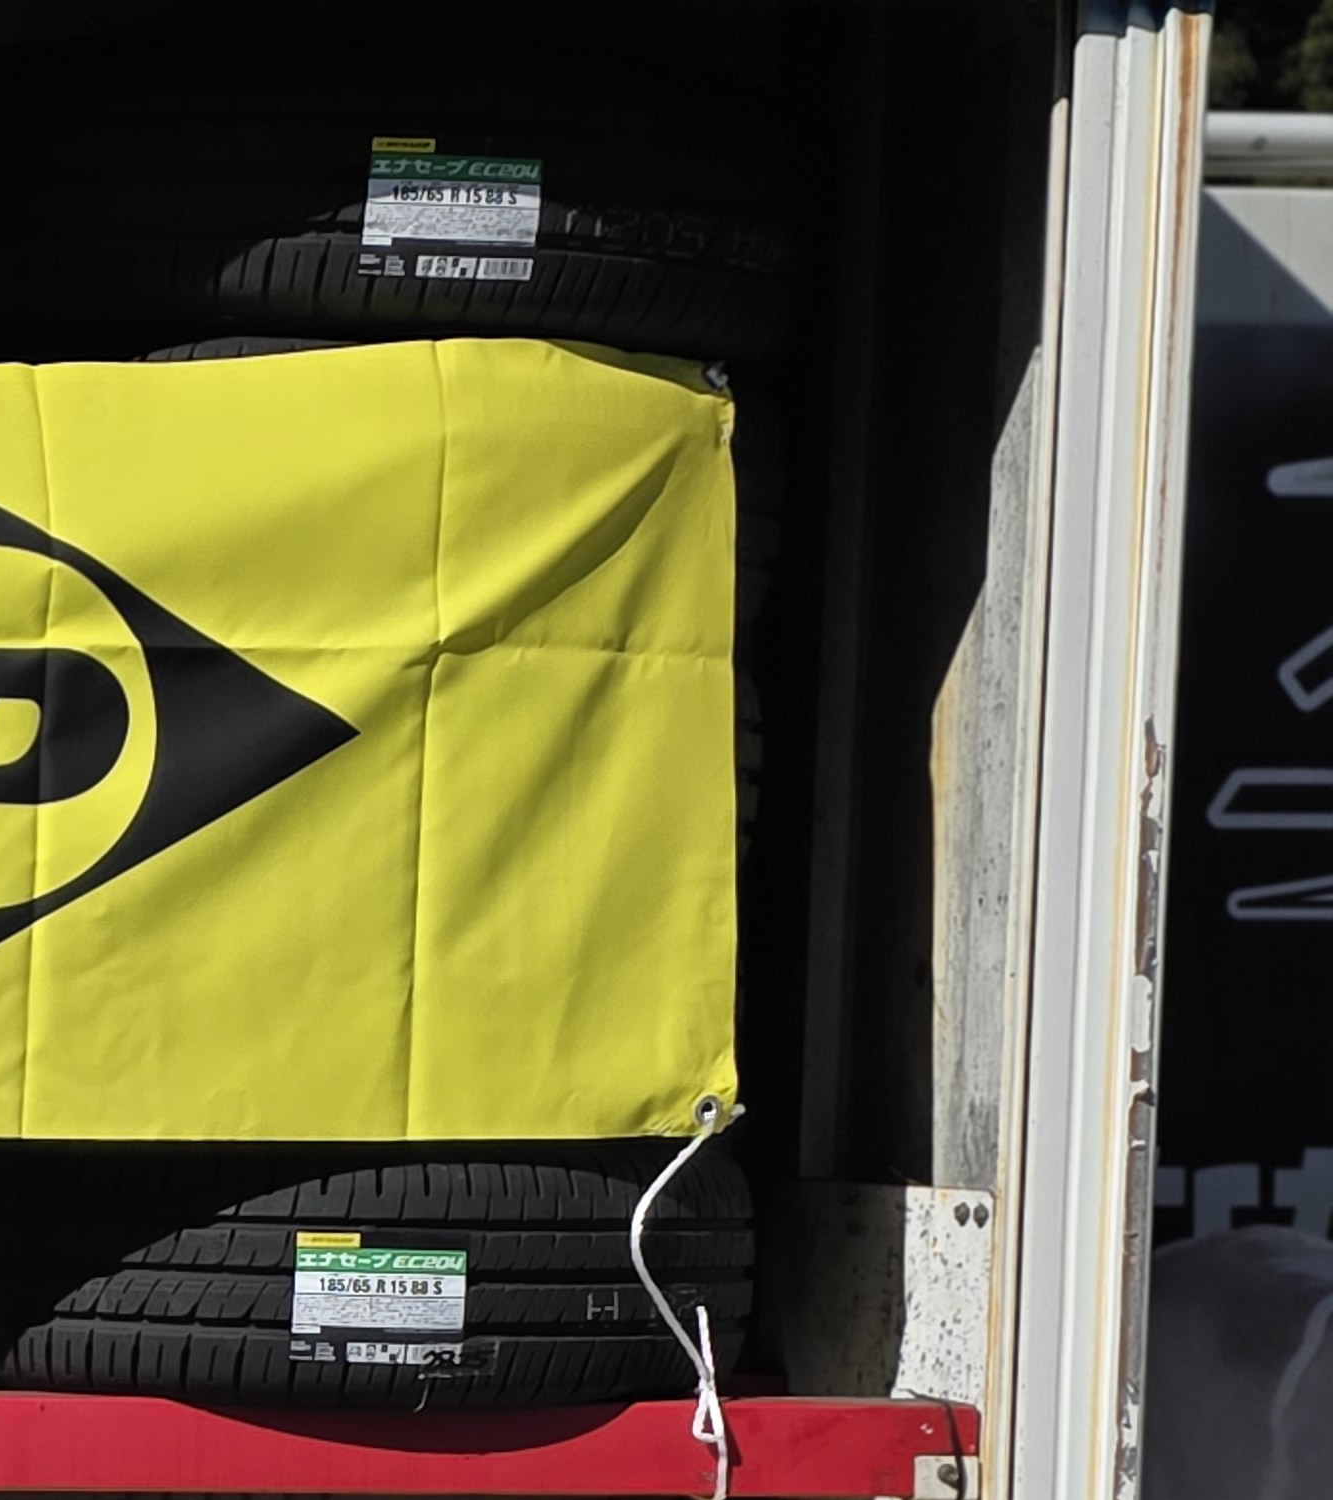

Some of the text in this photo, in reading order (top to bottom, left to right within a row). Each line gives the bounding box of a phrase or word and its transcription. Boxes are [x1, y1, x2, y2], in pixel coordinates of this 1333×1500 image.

[298, 1252, 464, 1270] エナセーブ EC204
[319, 1278, 443, 1295] 185/65 R 15 88 S
